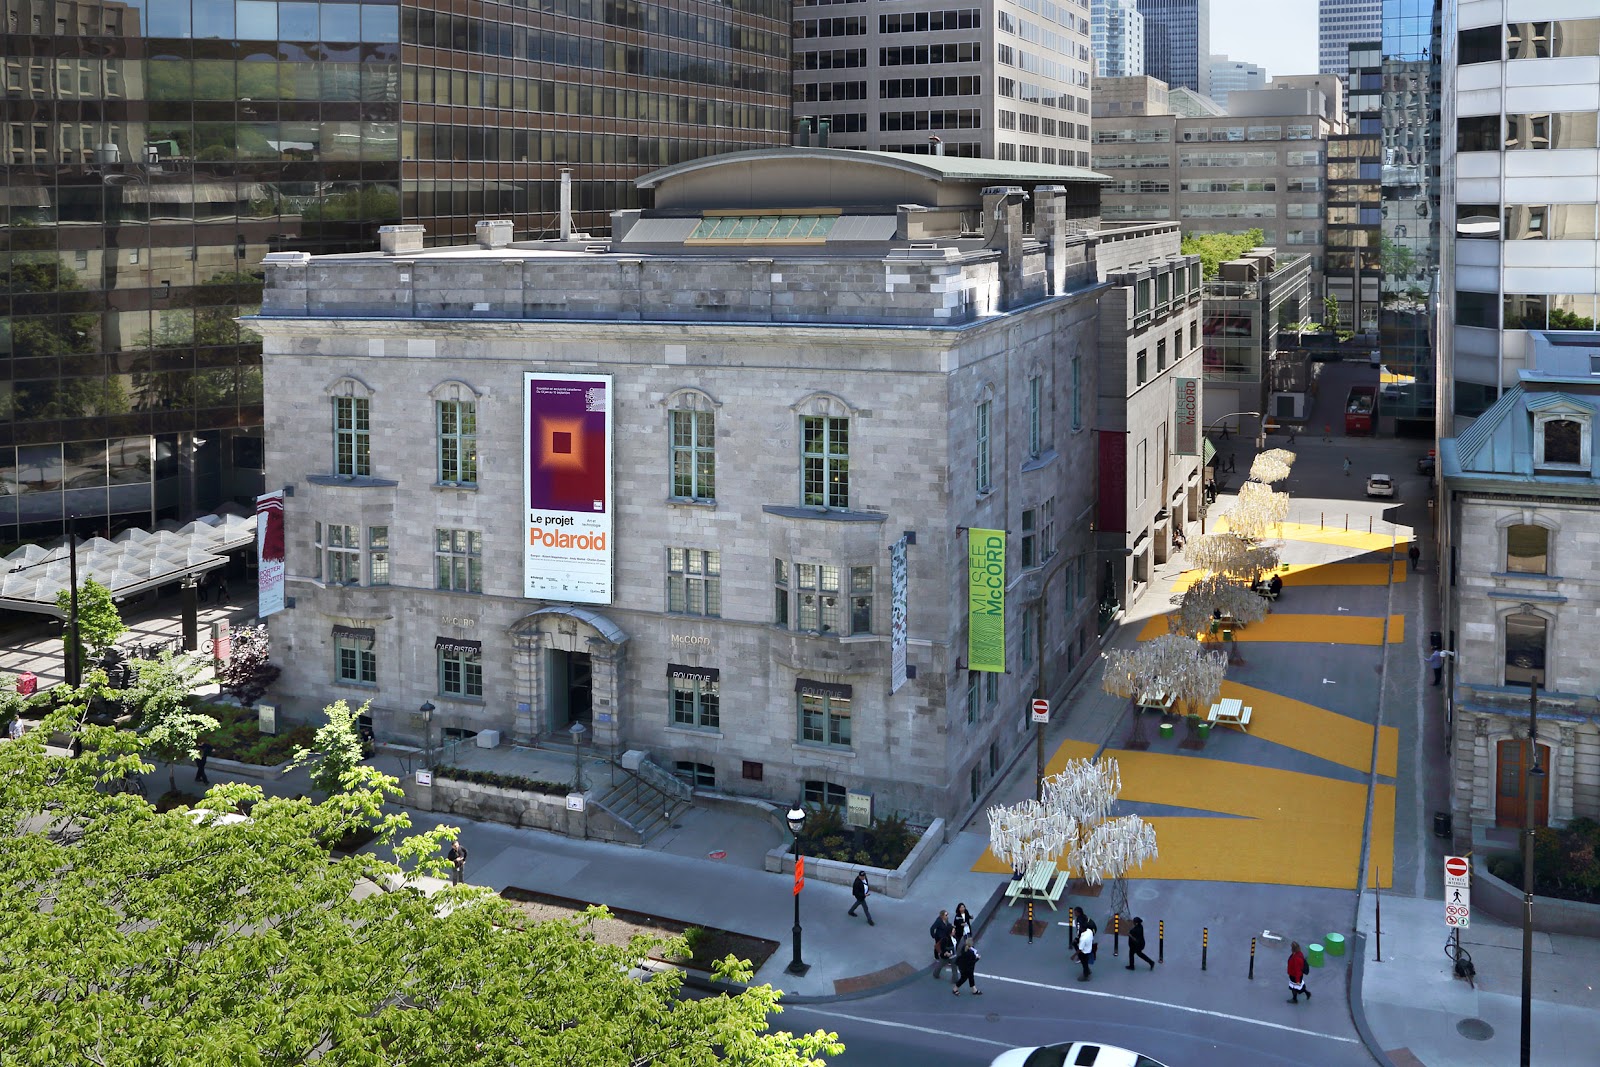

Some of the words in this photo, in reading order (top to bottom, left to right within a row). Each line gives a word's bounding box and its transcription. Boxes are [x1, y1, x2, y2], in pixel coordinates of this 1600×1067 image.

[1186, 381, 1196, 426] McCORD
[530, 513, 543, 523] Le
[545, 515, 574, 527] projet
[530, 527, 606, 551] Polaroid
[970, 545, 987, 615] MUSÉE
[987, 536, 1003, 616] McCORD
[671, 633, 711, 646] McCORD
[453, 645, 478, 654] BISTRO
[672, 671, 711, 683] BOUTIQUE
[801, 686, 843, 699] BOUTIQUE
